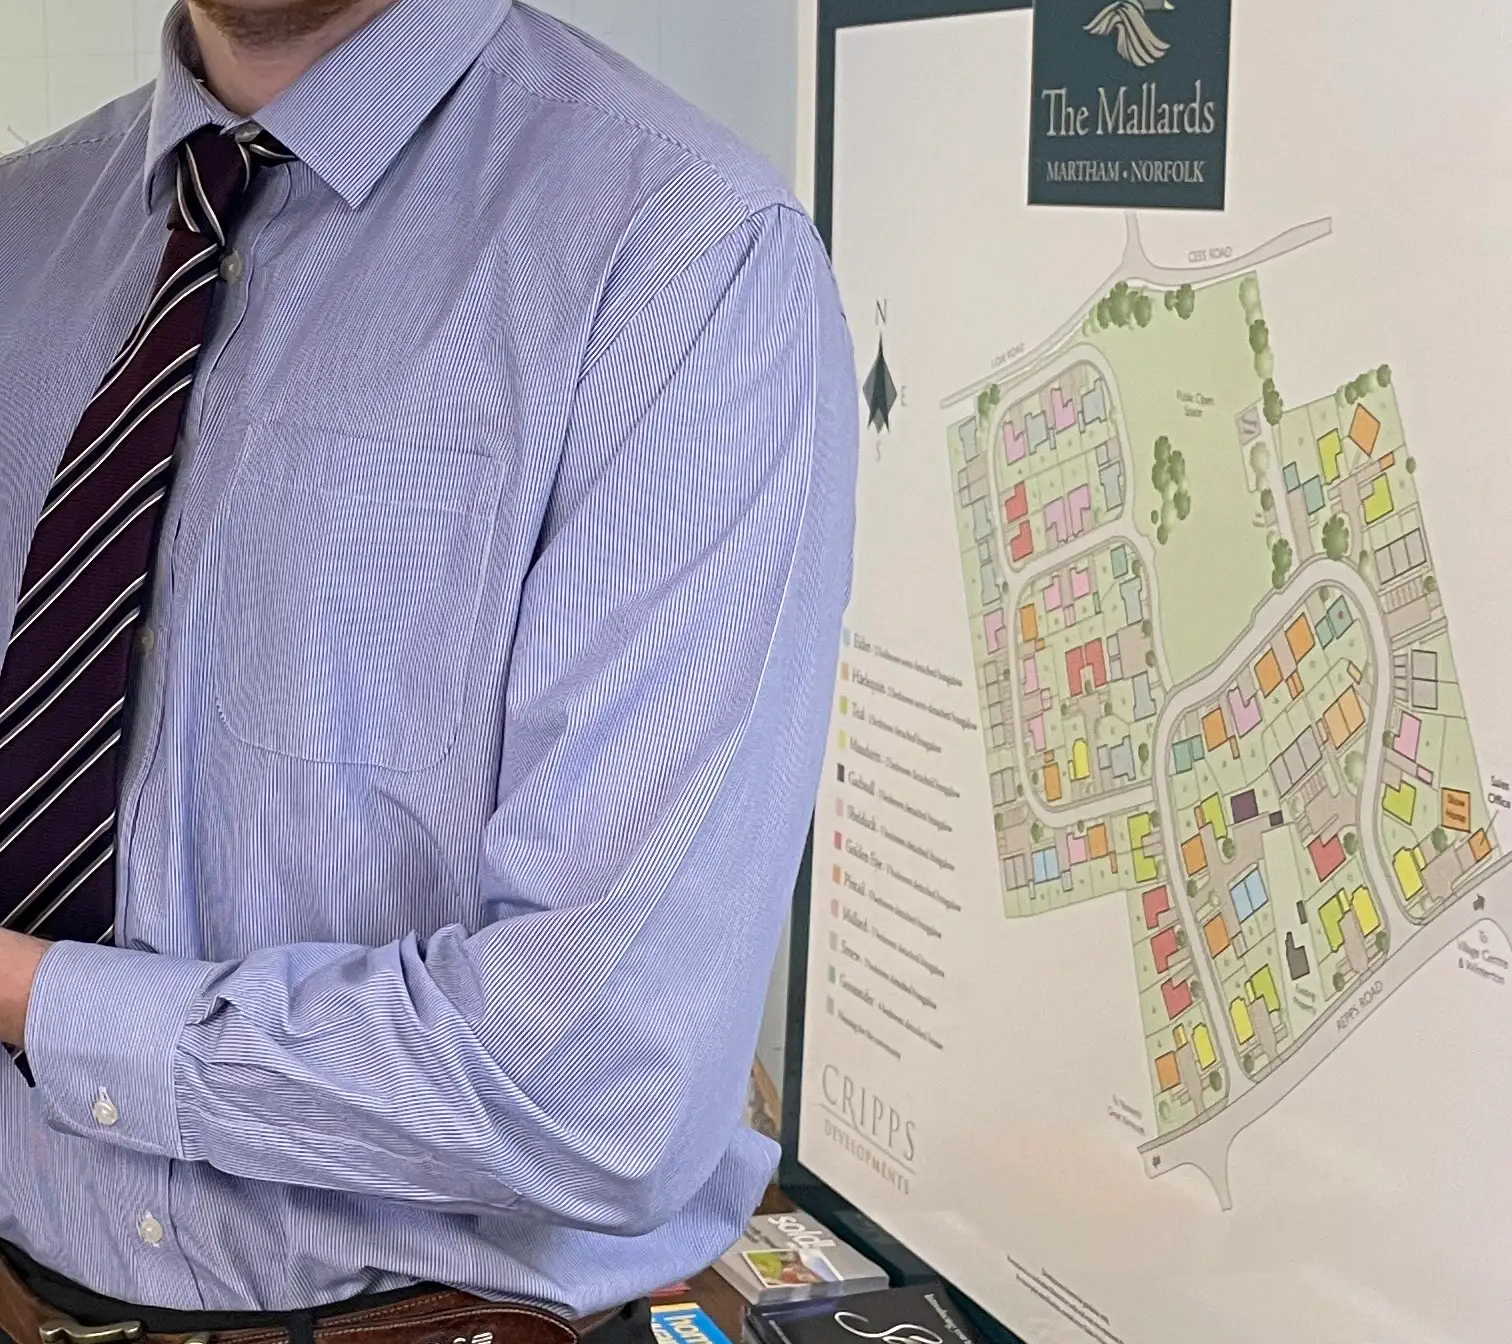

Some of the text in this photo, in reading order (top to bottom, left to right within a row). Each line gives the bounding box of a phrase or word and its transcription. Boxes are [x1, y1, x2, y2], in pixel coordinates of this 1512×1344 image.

[1040, 79, 1215, 137] The Mallards
[1045, 160, 1205, 183] MARTHAM NORFOLK
[874, 298, 887, 326] N
[821, 1063, 916, 1162] CRIPPS
